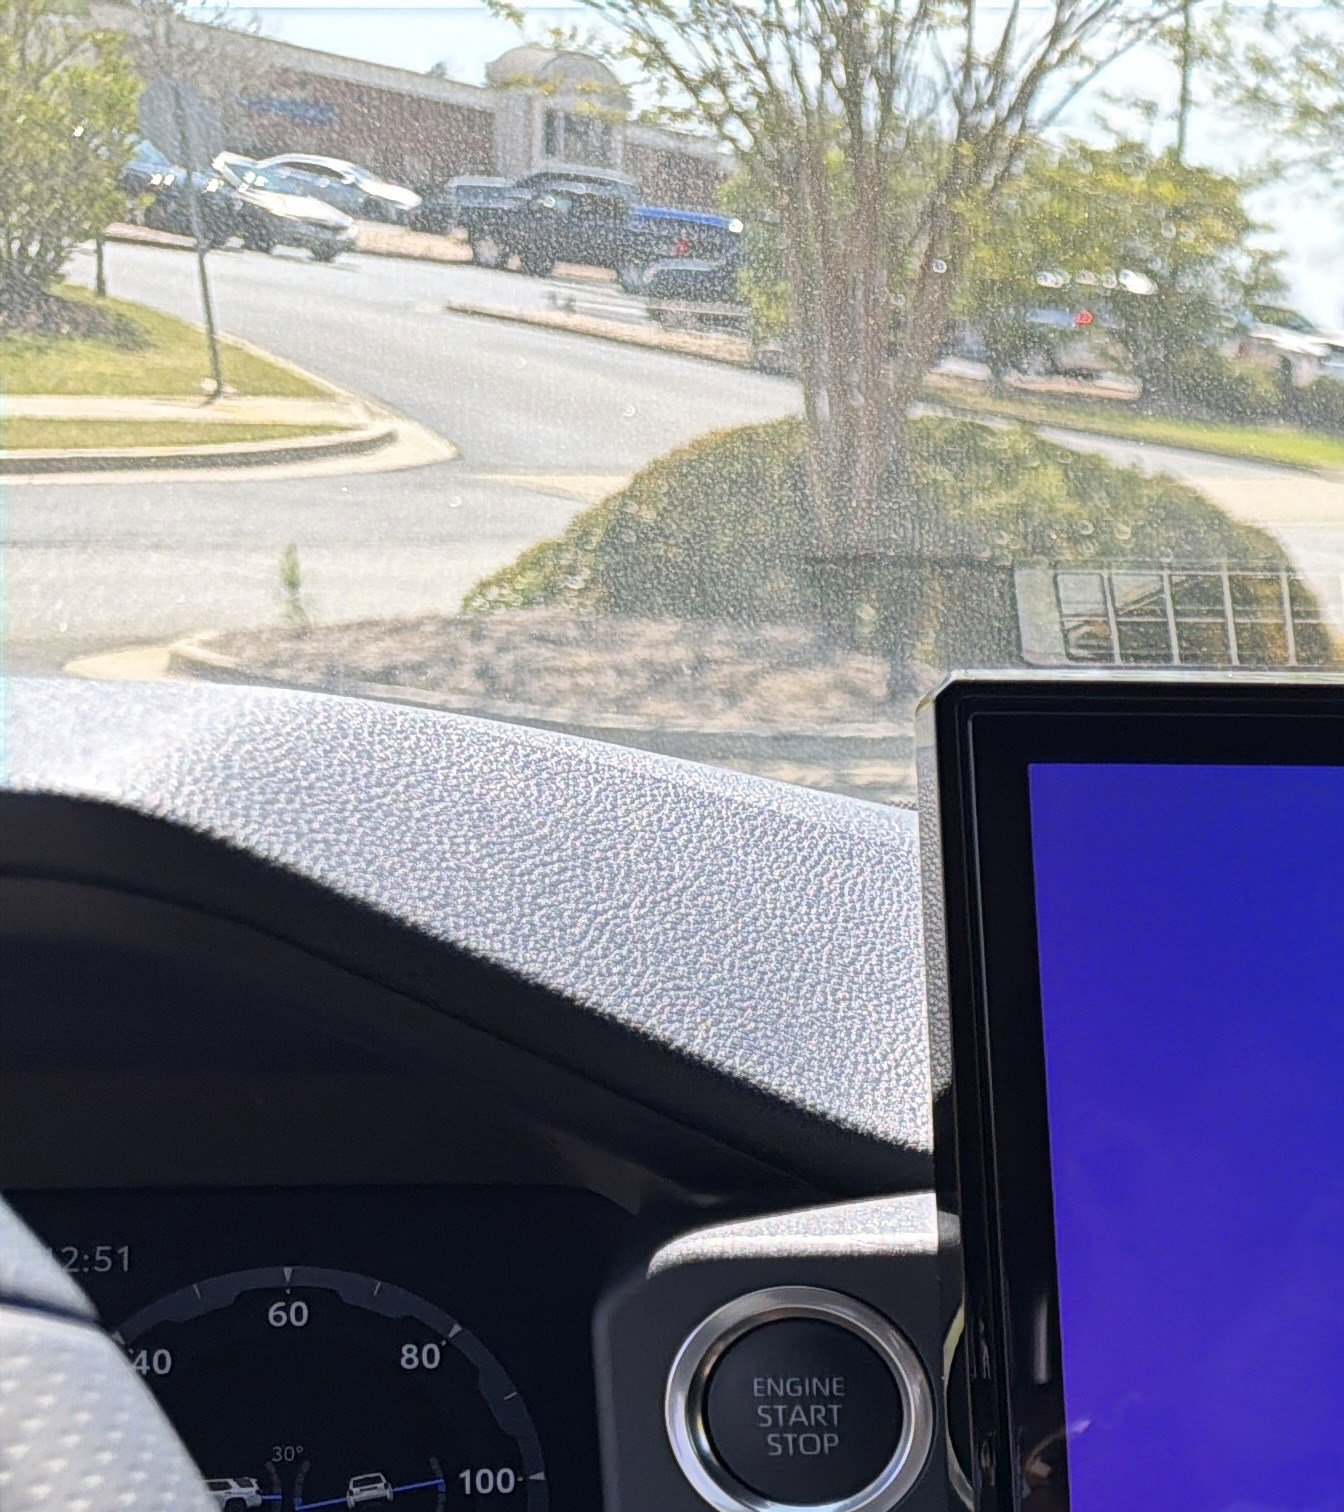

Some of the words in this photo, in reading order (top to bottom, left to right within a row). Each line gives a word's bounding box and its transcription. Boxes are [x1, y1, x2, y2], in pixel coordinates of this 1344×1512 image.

[48, 1245, 130, 1273] 2:51
[267, 1300, 309, 1328] 60
[133, 1348, 172, 1375] 40
[400, 1342, 441, 1370] 80
[753, 1376, 846, 1397] ENGINE
[757, 1404, 843, 1428] START
[766, 1432, 841, 1457] STOP
[458, 1467, 516, 1496] 100
